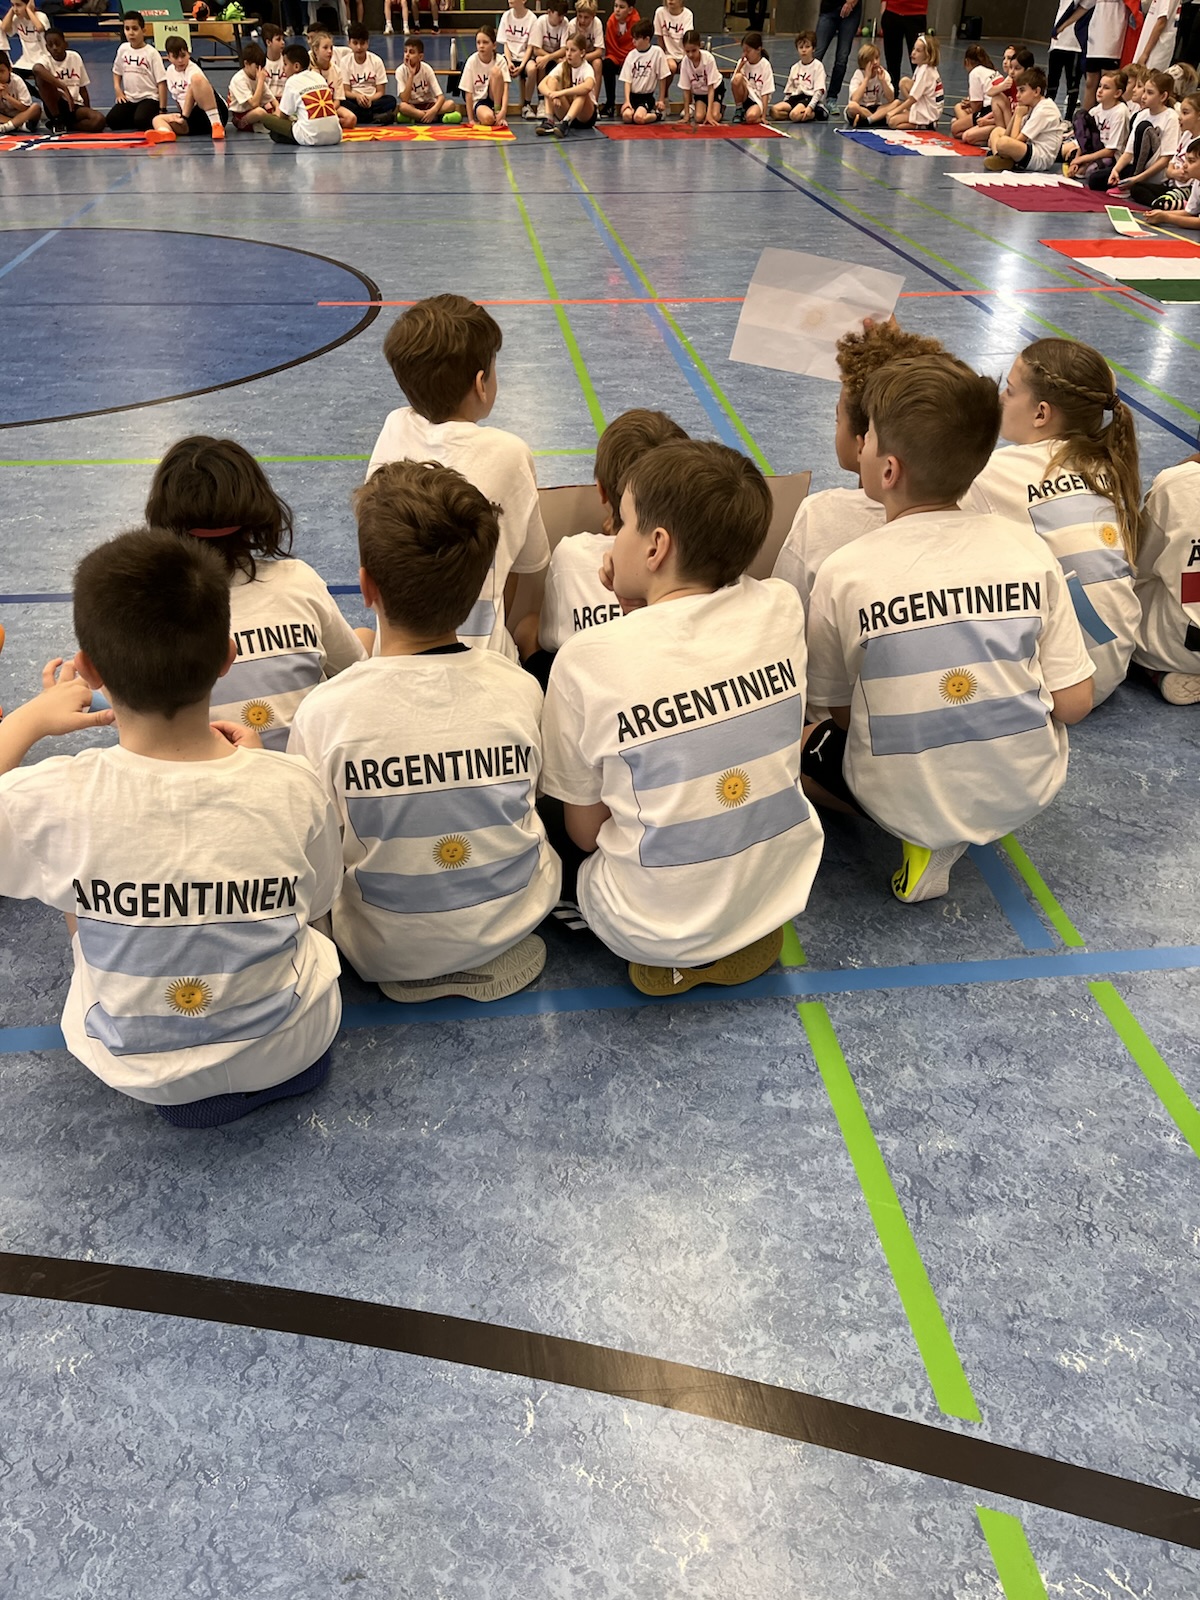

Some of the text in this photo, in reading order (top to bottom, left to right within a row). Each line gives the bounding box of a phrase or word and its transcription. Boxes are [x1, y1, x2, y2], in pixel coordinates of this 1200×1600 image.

[124, 55, 149, 69] AHA
[573, 604, 620, 632] ARGE
[859, 581, 1041, 636] ARGENTINIEN
[617, 658, 797, 743] ARGENTINIEN
[344, 744, 531, 791] ARGENTINIEN
[72, 875, 298, 918] ARGENTINIEN
